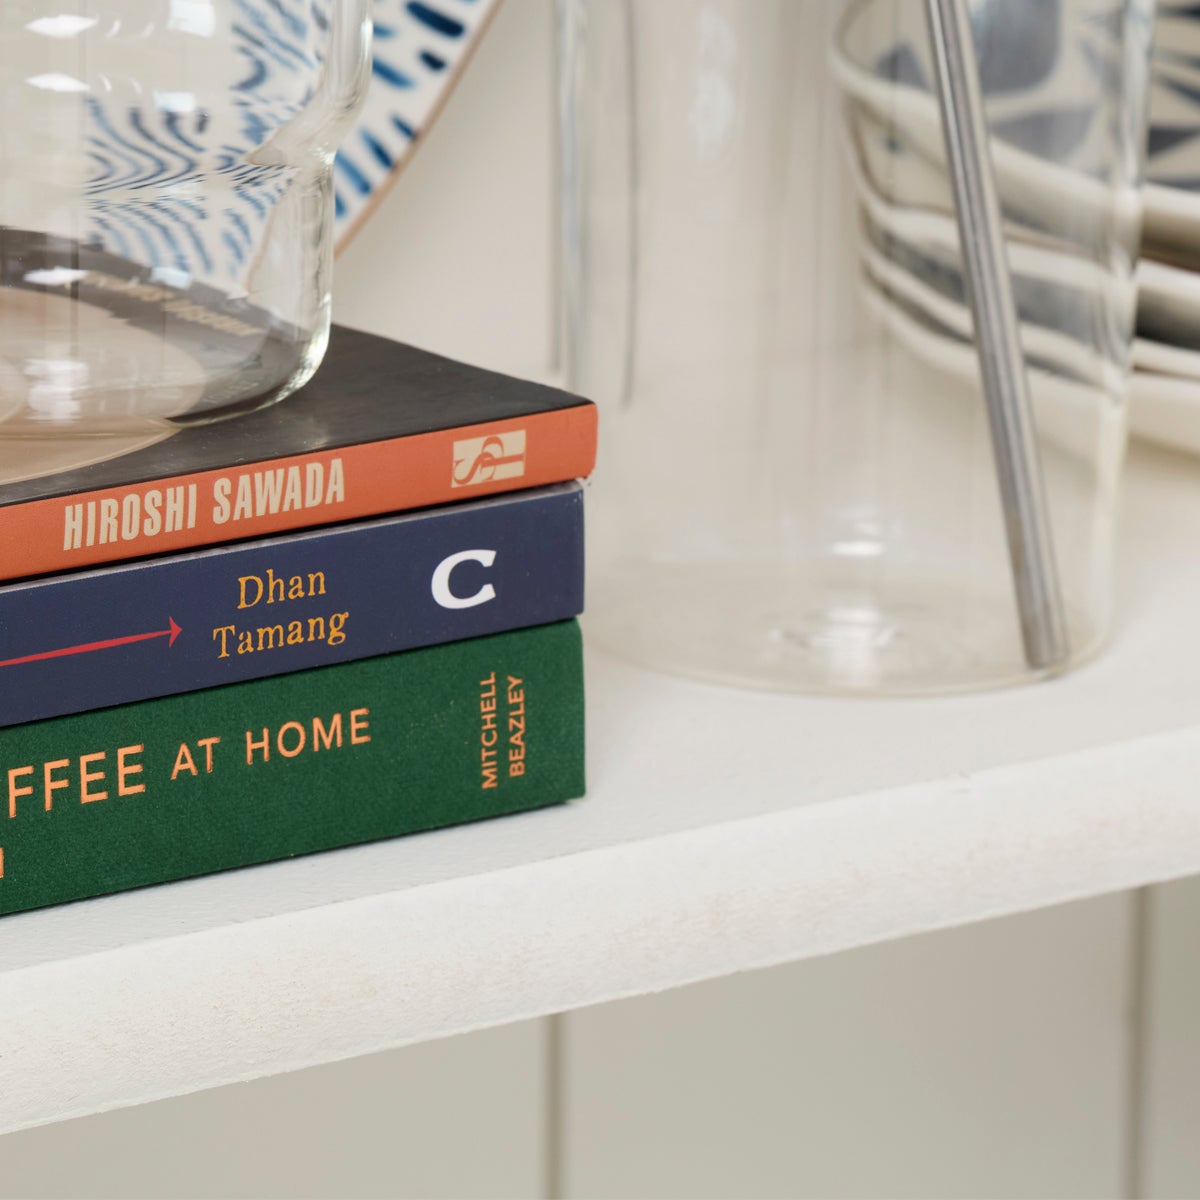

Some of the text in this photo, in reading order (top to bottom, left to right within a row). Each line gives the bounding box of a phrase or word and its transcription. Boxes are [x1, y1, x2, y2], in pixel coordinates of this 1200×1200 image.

[64, 458, 344, 550] HIROSHI SAWADA
[238, 569, 325, 608] Dhan
[432, 550, 496, 609] C
[214, 612, 348, 657] Tamang
[172, 737, 220, 779] AT
[246, 708, 370, 764] HOME
[481, 673, 497, 788] MITCHELL
[508, 676, 525, 776] BEAZLEY
